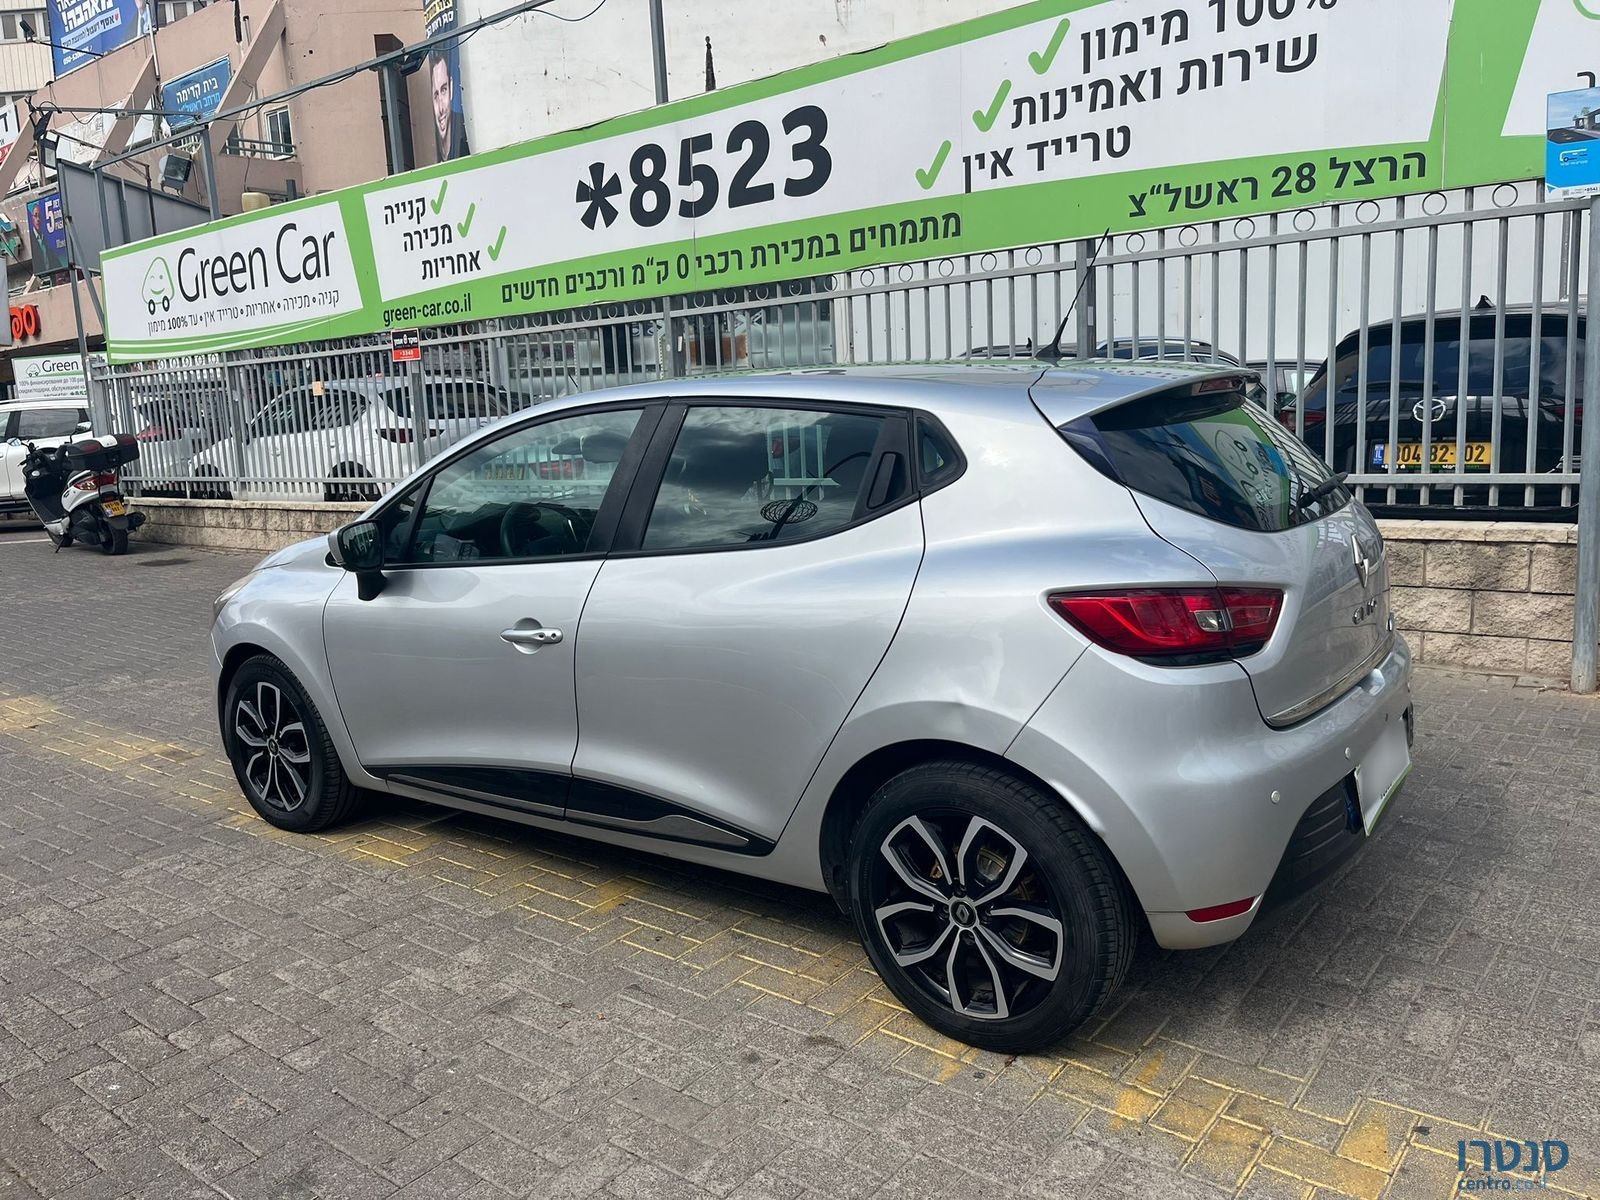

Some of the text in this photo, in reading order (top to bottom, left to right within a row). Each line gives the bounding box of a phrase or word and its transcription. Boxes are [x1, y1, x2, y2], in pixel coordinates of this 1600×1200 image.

[1080, 0, 1337, 74] 10 מימון
[203, 77, 219, 93] בית
[1011, 33, 1318, 129] שירות ואמינות
[962, 125, 1131, 194] טרייד אין
[1329, 151, 1427, 189] הרצל
[1271, 162, 1316, 198] 28
[384, 197, 426, 225] קנייה
[403, 224, 453, 252] מכירה
[850, 212, 961, 252] מתמחים
[178, 223, 335, 303] Green Car
[422, 250, 481, 280] אחריות
[677, 253, 689, 279] 0
[696, 249, 743, 276] רכבי
[750, 233, 841, 268] במכירת
[501, 277, 559, 303] חדשים
[566, 267, 625, 294] ורכבים
[147, 289, 340, 336] קניה מכירה אחריות טרייד אין עד 100% מימון
[383, 293, 471, 327] green-car.co.il
[42, 360, 79, 372] Green
